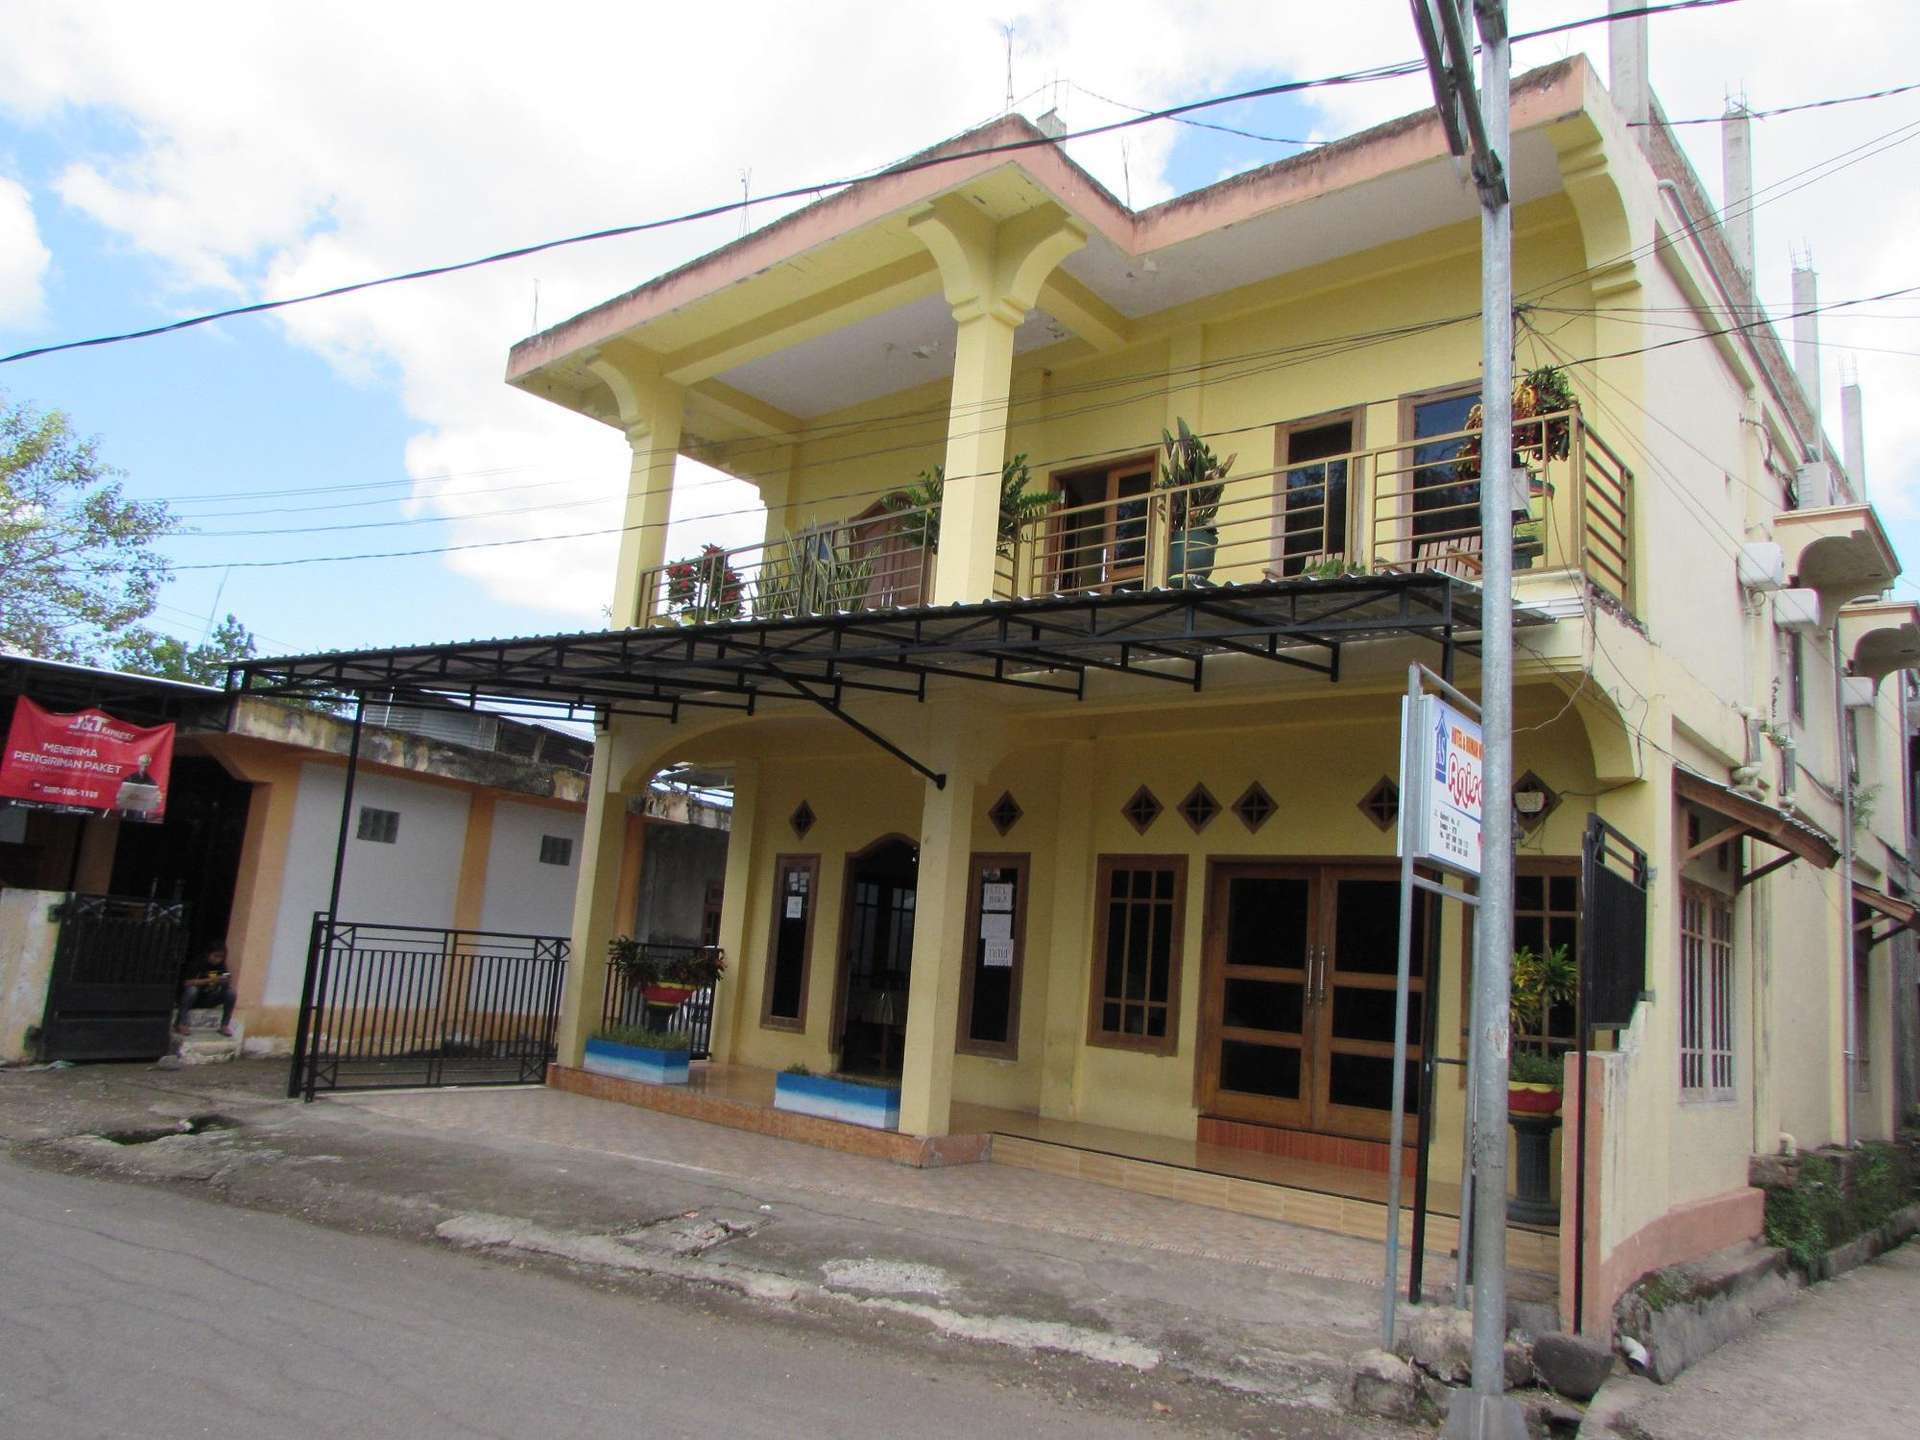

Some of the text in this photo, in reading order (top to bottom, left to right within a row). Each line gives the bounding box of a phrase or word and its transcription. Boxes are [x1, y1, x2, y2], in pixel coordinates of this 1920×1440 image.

[69, 715, 112, 732] J&T
[43, 743, 97, 757] MENERIMA
[13, 750, 83, 769] PENGIRIMAN
[83, 760, 123, 775] PAKET
